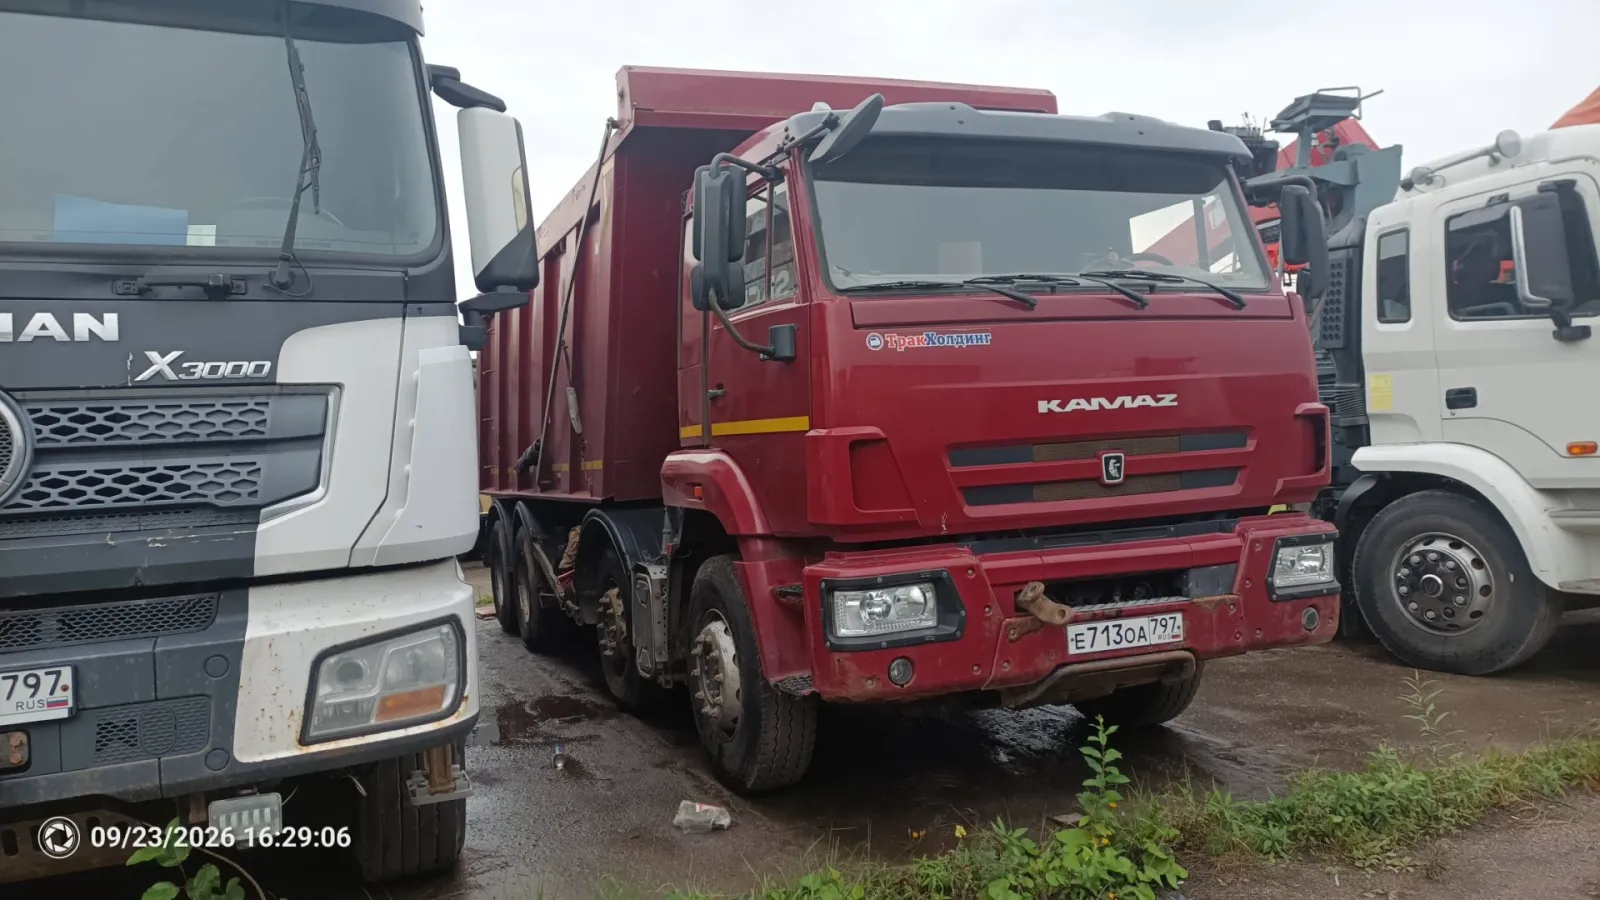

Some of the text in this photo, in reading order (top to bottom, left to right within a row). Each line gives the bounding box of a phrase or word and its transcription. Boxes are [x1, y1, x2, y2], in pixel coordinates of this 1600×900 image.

[0, 313, 119, 342] AN
[885, 332, 992, 351] ТракХолдинг
[133, 350, 272, 381] X3000
[1037, 393, 1178, 413] KAMAZ
[1151, 616, 1177, 635] 797
[1157, 632, 1172, 641] RUS
[1, 670, 62, 701] 797
[16, 699, 46, 711] RUS
